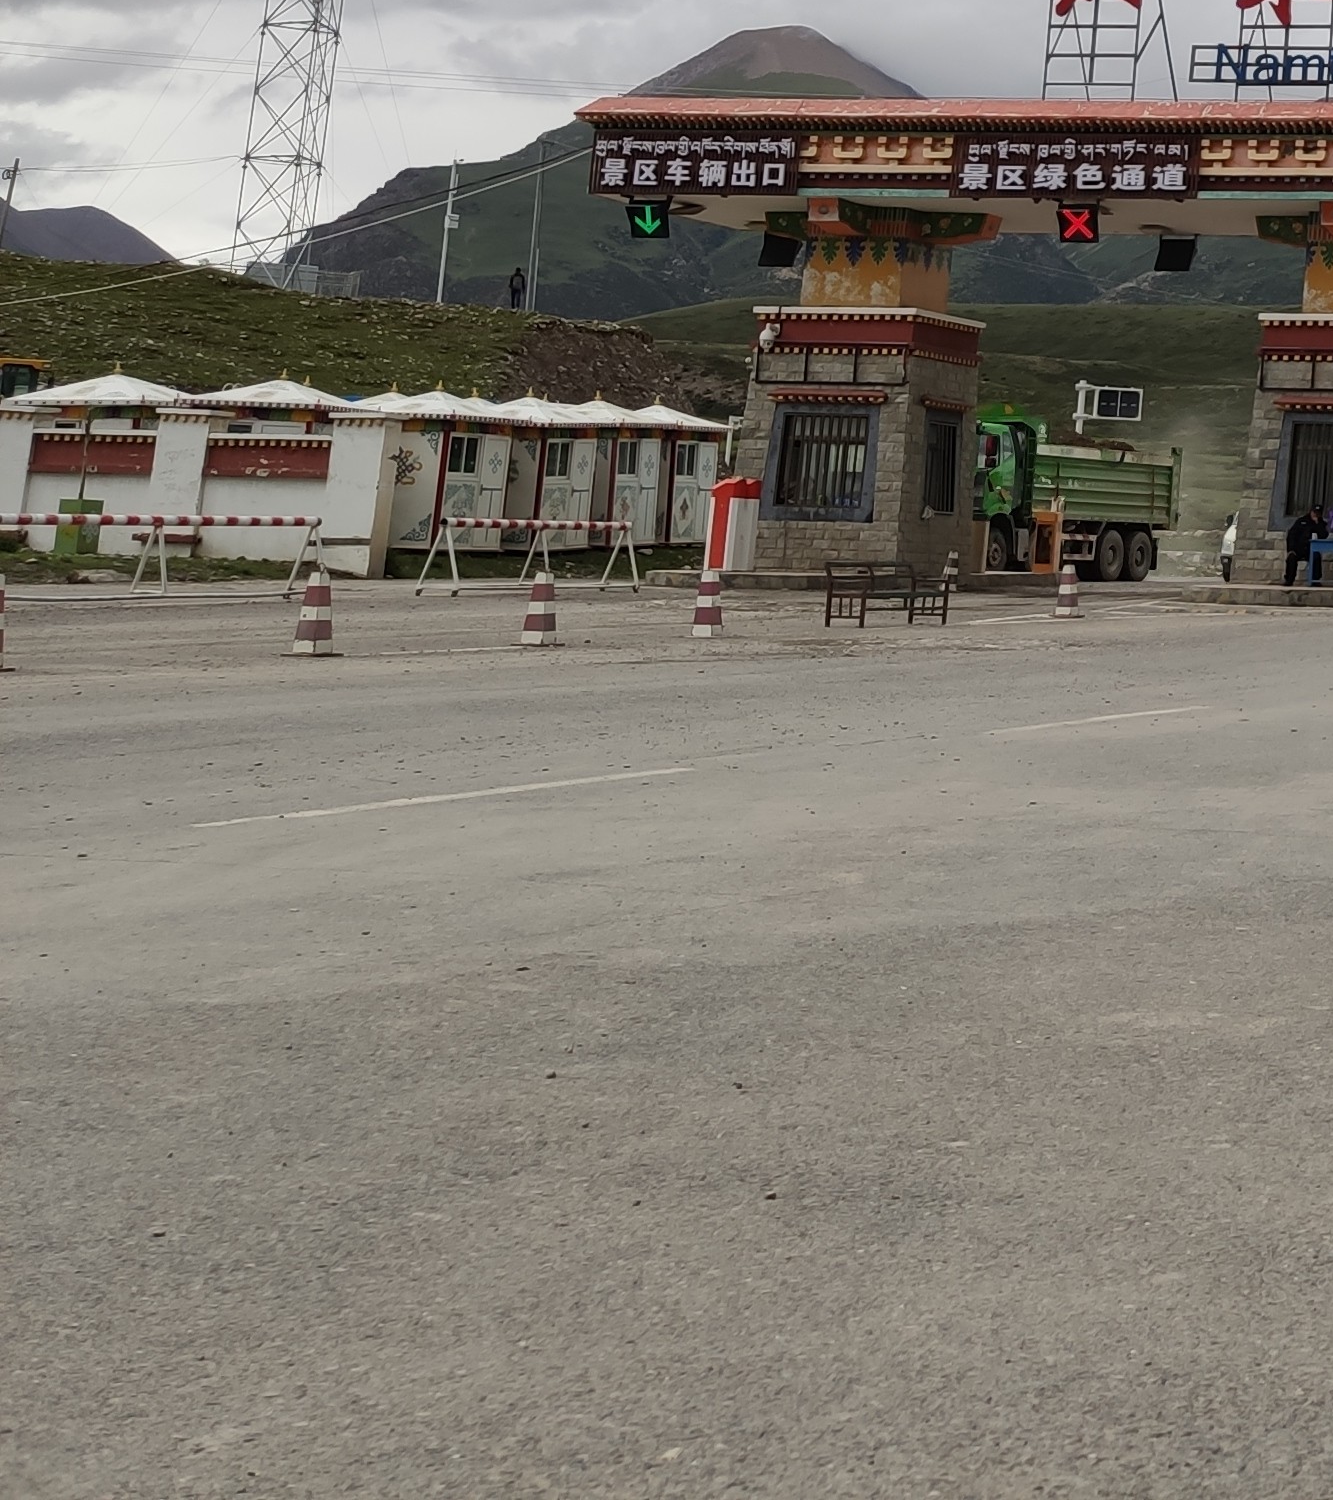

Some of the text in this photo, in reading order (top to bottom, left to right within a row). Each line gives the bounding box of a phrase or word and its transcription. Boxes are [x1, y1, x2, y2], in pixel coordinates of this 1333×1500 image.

[600, 158, 787, 188] 景区车辆出口
[958, 163, 1188, 191] 景区绿色通道
